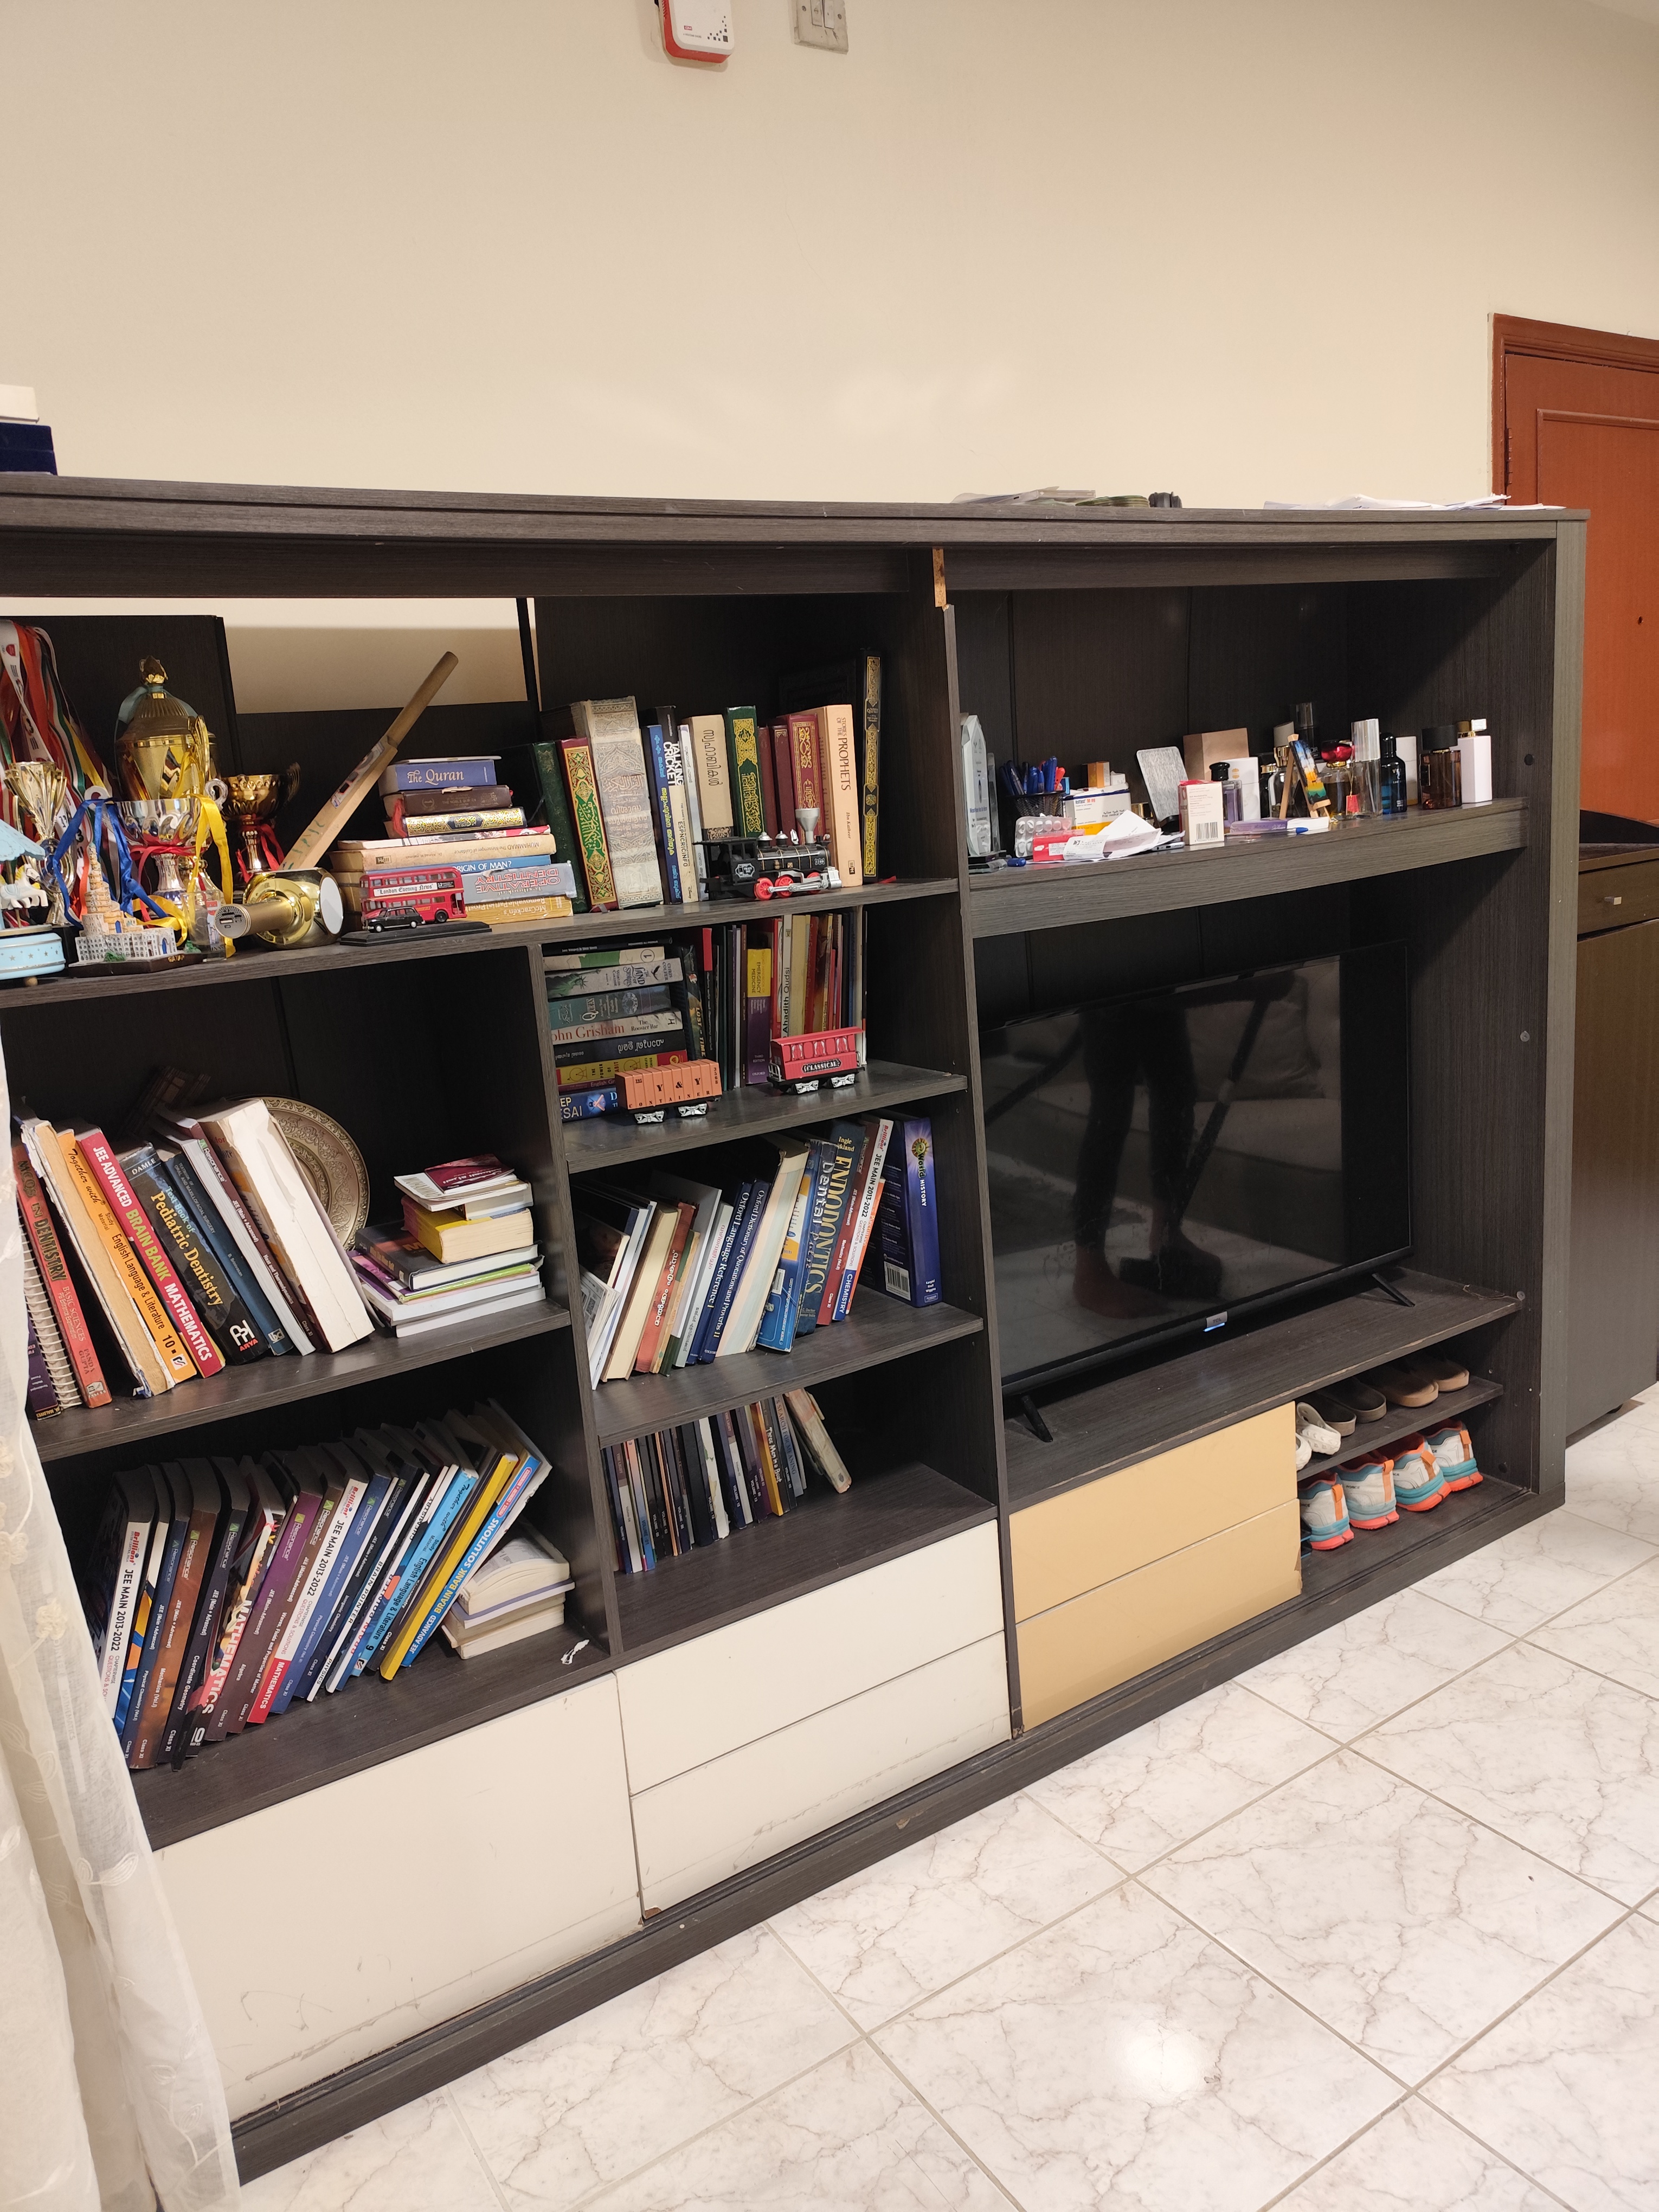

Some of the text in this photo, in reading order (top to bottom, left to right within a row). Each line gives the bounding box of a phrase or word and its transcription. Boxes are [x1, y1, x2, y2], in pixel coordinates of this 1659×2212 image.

[407, 769, 465, 786] The Quran
[663, 742, 676, 786] CRICKET
[672, 741, 684, 786] TALKING
[838, 738, 851, 790] PROPHETS
[507, 841, 539, 851] MUHAMMAD
[678, 821, 688, 867] ESPNCRICINFO
[475, 867, 559, 884] DENTISTRY
[478, 863, 488, 871] OF
[490, 860, 512, 869] MAN?
[399, 885, 418, 893] Evening
[476, 876, 561, 893] OPERATIVE
[552, 1024, 625, 1041] ohn Grisham
[806, 1062, 837, 1072] CLASSICAL
[629, 1090, 710, 1108] CONTAINER
[839, 1136, 852, 1144] Ingle
[880, 1125, 889, 1150] Brilliant
[68, 1148, 99, 1204] Together with
[131, 1158, 156, 1175] DAMLE
[203, 1148, 226, 1182] Resonance
[869, 1167, 879, 1185] MAIN
[31, 1203, 43, 1217] IN
[165, 1186, 196, 1233] Text Book of
[735, 1192, 749, 1221] Oxford
[754, 1190, 765, 1211] Oxford
[861, 1186, 874, 1217] 2013-2022
[741, 1211, 758, 1245] Dictionary
[805, 1156, 853, 1294] ENDODONTICS
[33, 1218, 68, 1281] DENTISTRY
[93, 1146, 212, 1361] JEE ADVANCED BRAIN BANK MATHEMATICS
[151, 1191, 223, 1306] Pediatric Dentistry
[721, 1220, 741, 1263] Language
[741, 1245, 746, 1256] of
[708, 1263, 728, 1304] Reference
[729, 1255, 745, 1289] Quotations
[112, 1233, 130, 1261] English
[125, 1258, 145, 1291] Language
[144, 1297, 165, 1330] Literature
[162, 1335, 176, 1348] 10
[839, 1274, 853, 1314] CHEMISTRY
[62, 1286, 86, 1342] BASIC SCIENCES
[716, 1300, 730, 1331] Proverbs
[83, 1349, 95, 1373] PANDA
[240, 1339, 259, 1352] ARYA
[79, 1350, 90, 1375] GUPTA
[777, 1405, 787, 1429] SEARCH
[782, 1429, 790, 1445] FOR
[785, 1445, 797, 1475] MEANING
[343, 1487, 358, 1516] Brilliant
[385, 1487, 403, 1518] Resonance
[311, 1509, 330, 1545] Resonance
[357, 1504, 372, 1535] Resonance
[129, 1531, 140, 1563] Brilliant
[222, 1532, 238, 1568] Resonance
[284, 1522, 301, 1559] Resonance
[166, 1548, 178, 1583] Resonance
[184, 1540, 197, 1578] Resonance
[307, 1520, 344, 1596] JEE MAIN 2013-2022
[410, 1557, 427, 1578] English
[394, 1578, 414, 1606] Language
[409, 1517, 500, 1654] JEE ADVANCED BRAIN BANK SOLUTIONS
[111, 1569, 134, 1651] JEE MAIN 2013-2022
[294, 1599, 307, 1624] QUESTIONS
[299, 1600, 312, 1628] CHAPTERWISE
[317, 1561, 383, 1685] BRAIN POINTER PHYSICS
[373, 1611, 395, 1640] Literature
[202, 1600, 253, 1714] MATHEMATICS
[281, 1629, 295, 1655] SOLUTIONS
[110, 1655, 120, 1684] CHAPTERWISE
[177, 1655, 200, 1711] Coordinate Geometry
[236, 1664, 247, 1681] Algebra
[260, 1661, 285, 1709] MATHEMATICS
[168, 1730, 177, 1745] Class
